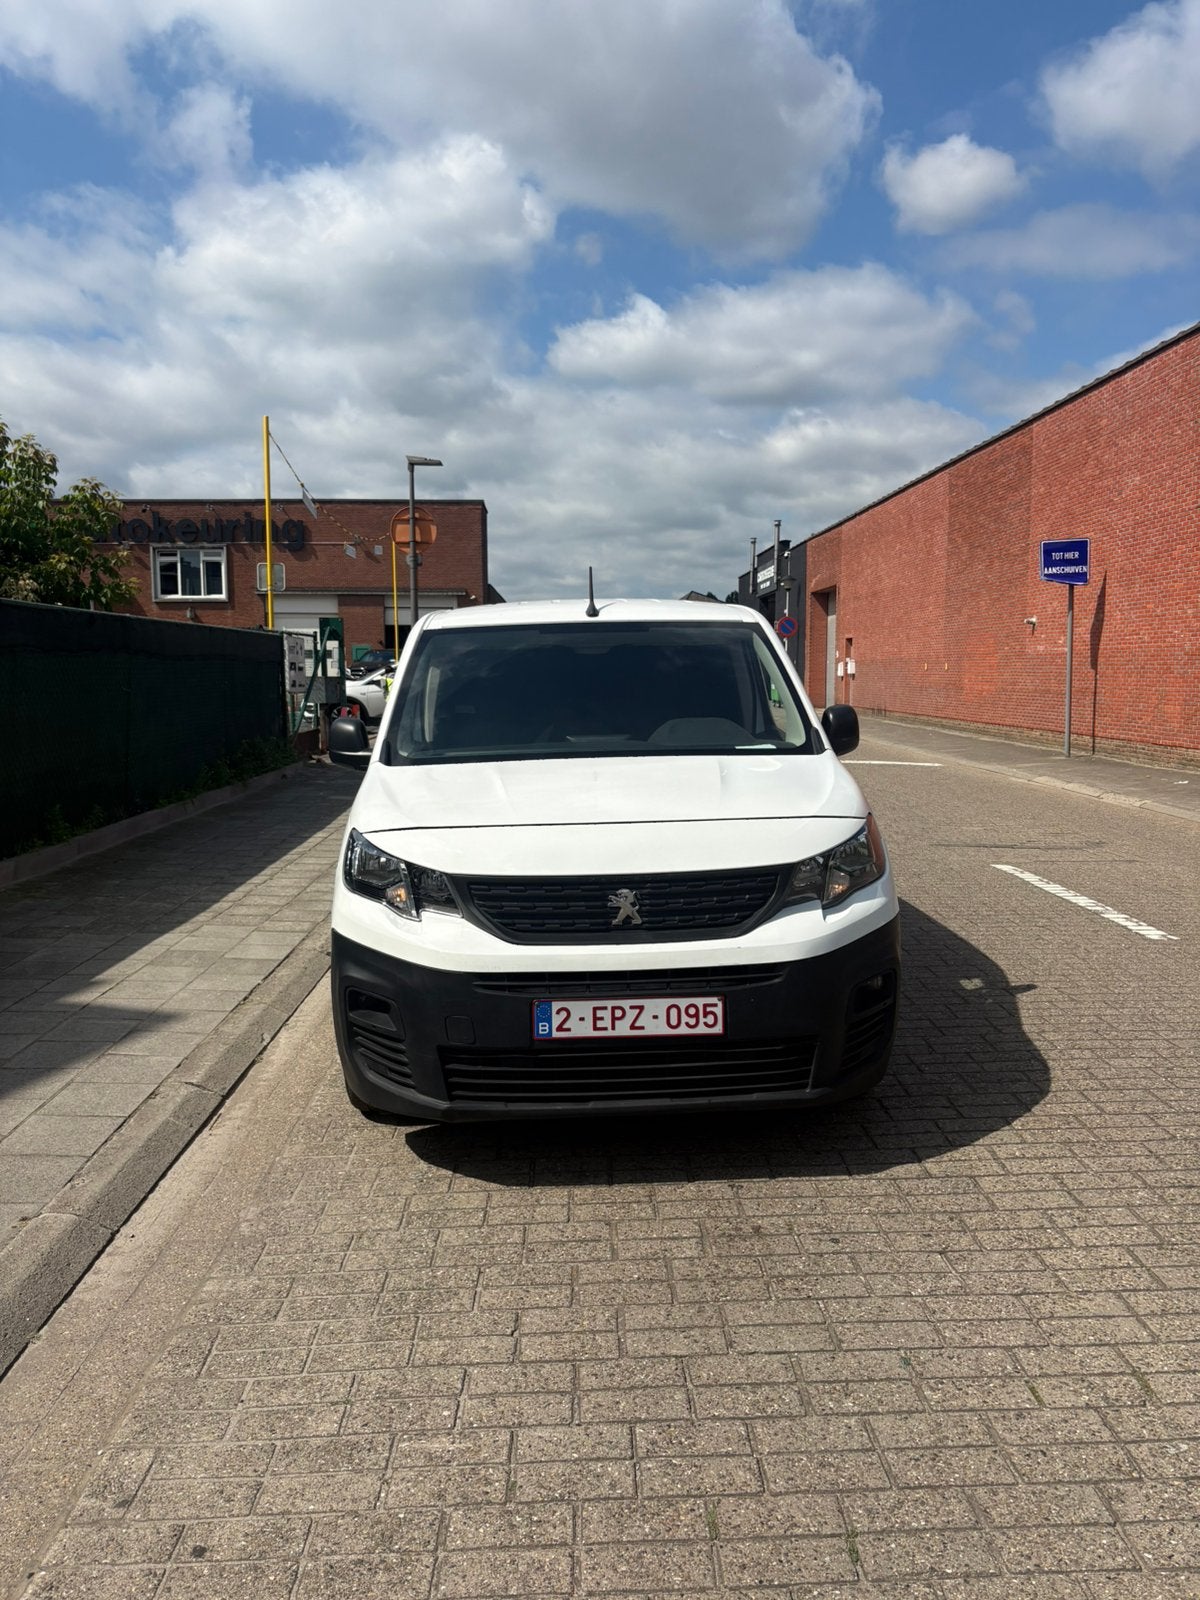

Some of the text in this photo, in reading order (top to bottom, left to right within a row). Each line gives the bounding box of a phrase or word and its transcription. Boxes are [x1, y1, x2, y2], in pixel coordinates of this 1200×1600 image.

[1051, 551, 1079, 560] TOT HIER
[1044, 565, 1087, 574] AANSCHUIVEN
[538, 1003, 718, 1034] B 2-EPZ-095
